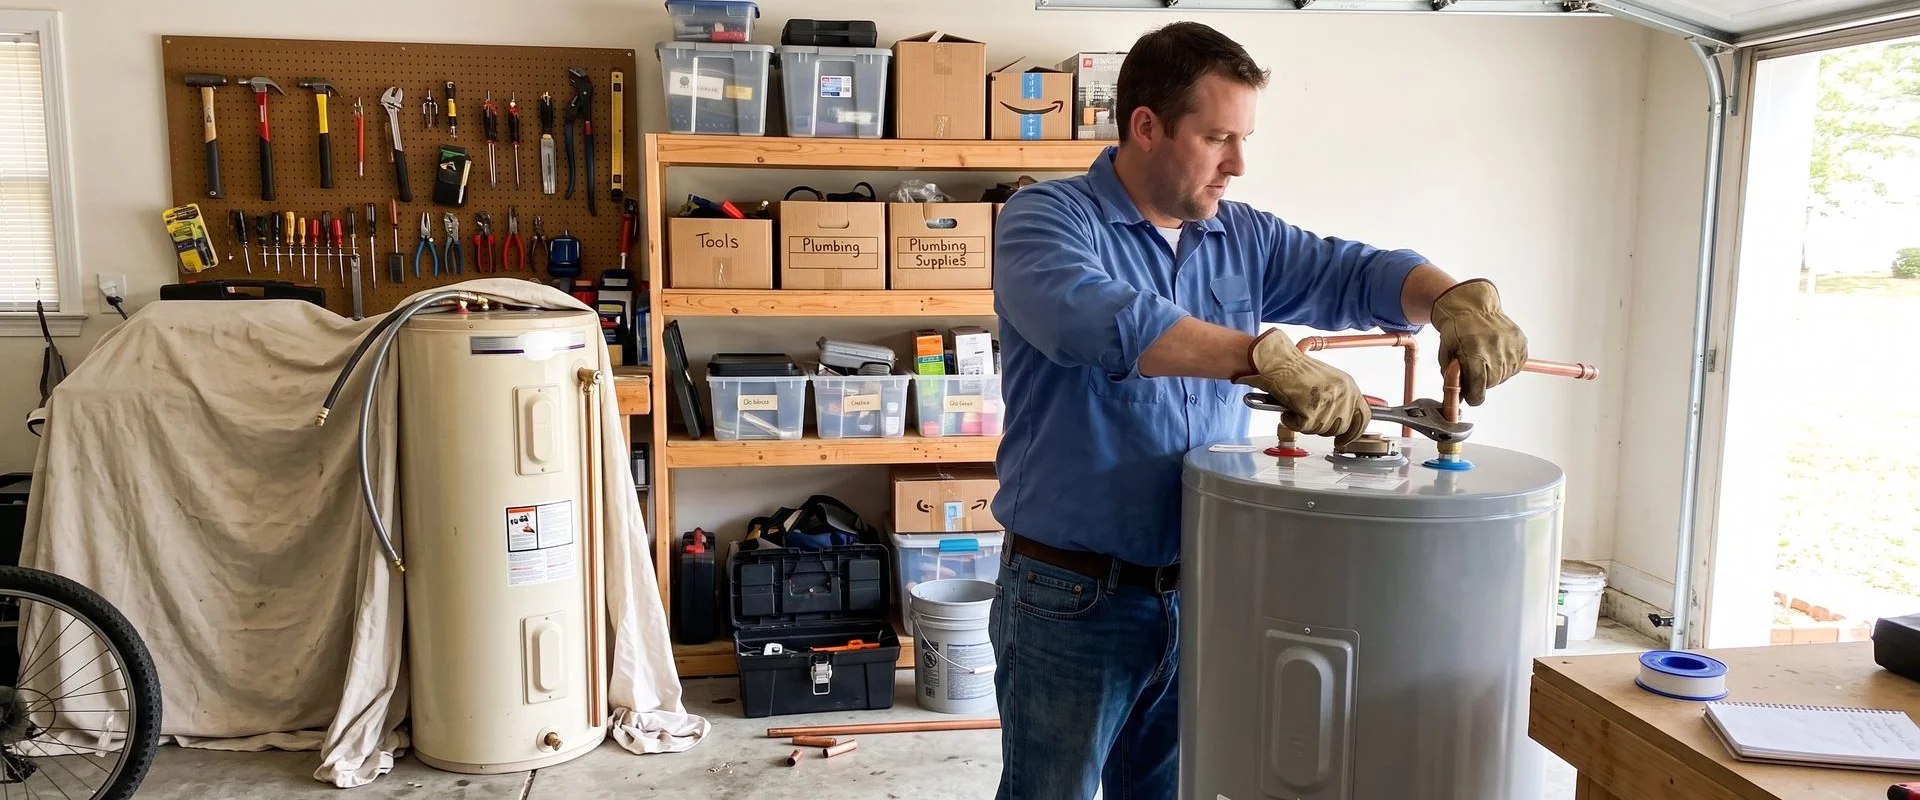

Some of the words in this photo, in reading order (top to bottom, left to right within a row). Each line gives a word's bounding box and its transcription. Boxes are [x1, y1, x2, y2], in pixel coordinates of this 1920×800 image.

[695, 232, 739, 249] Tools
[802, 237, 860, 258] Plumbing
[909, 238, 967, 257] Plumbing
[915, 254, 967, 270] Supplies
